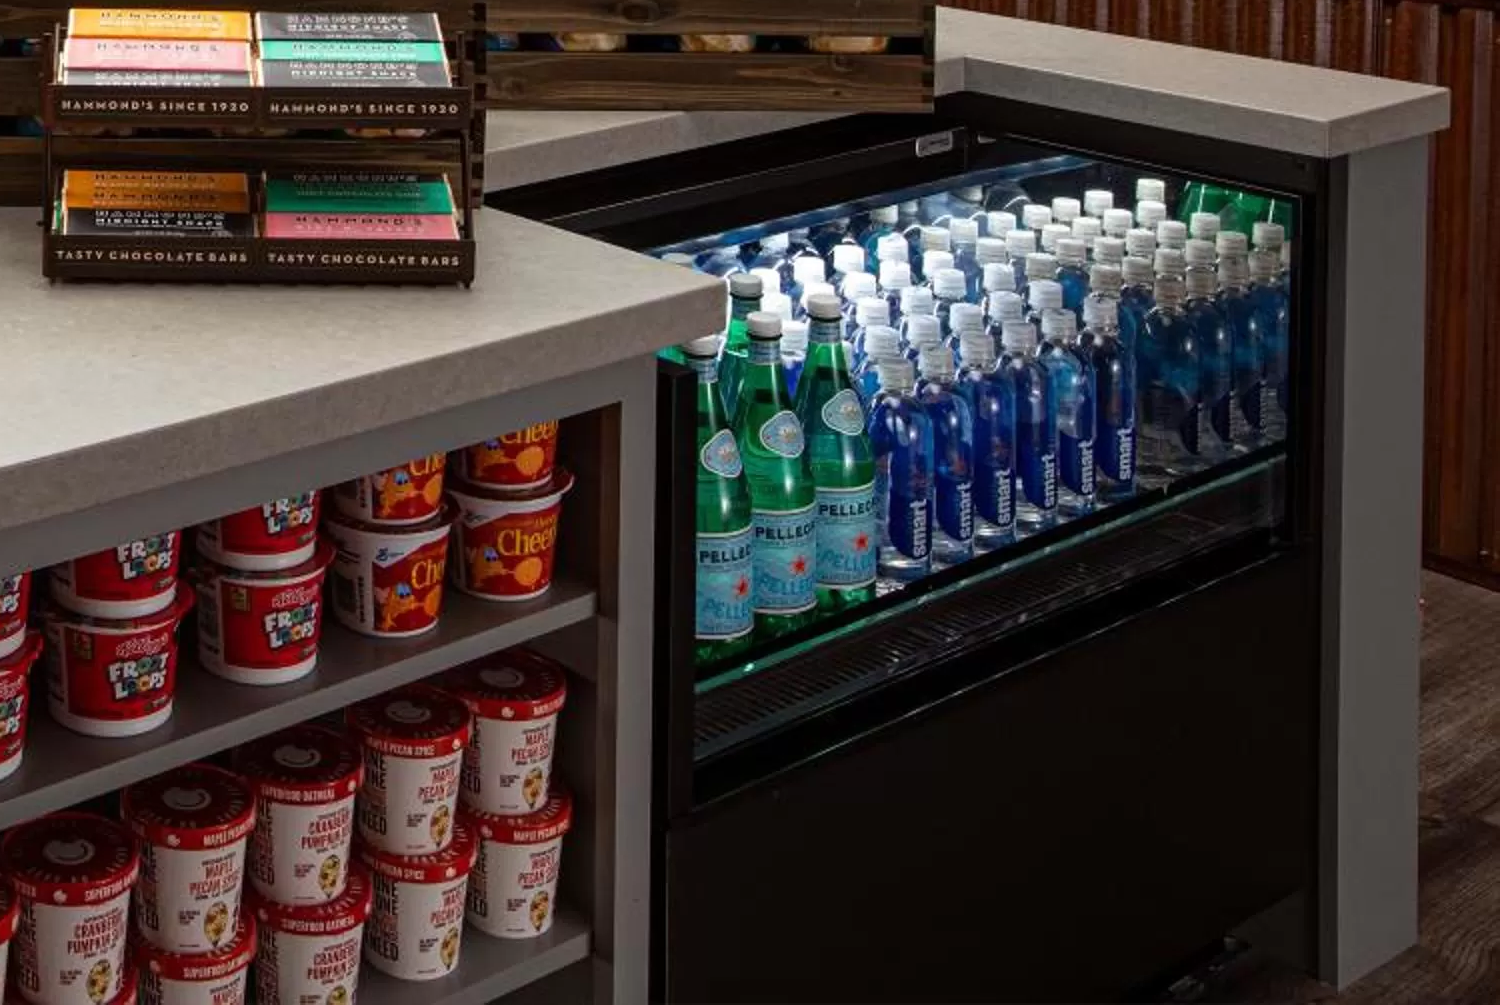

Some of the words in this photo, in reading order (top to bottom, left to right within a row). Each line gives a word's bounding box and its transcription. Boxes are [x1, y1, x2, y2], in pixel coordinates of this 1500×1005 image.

[61, 100, 153, 110] HAMMOND'S
[160, 101, 206, 111] SINCE
[212, 102, 250, 112] 1920
[270, 104, 362, 114] HAMMOND'S
[369, 104, 416, 114] SINCE
[421, 104, 459, 114] 1920
[56, 250, 104, 260] TASTY
[109, 251, 203, 262] CHOCOLATE
[208, 253, 248, 263] BARS
[268, 254, 316, 264] TASTY
[321, 255, 415, 265] CHOCOLATE
[421, 256, 460, 266] BARS
[1041, 454, 1056, 508] smart
[1077, 439, 1094, 494] smart
[1117, 427, 1132, 481] smart
[956, 482, 972, 539] smart
[993, 468, 1011, 524] smart
[909, 498, 927, 557] smart
[108, 652, 170, 683] FROOT
